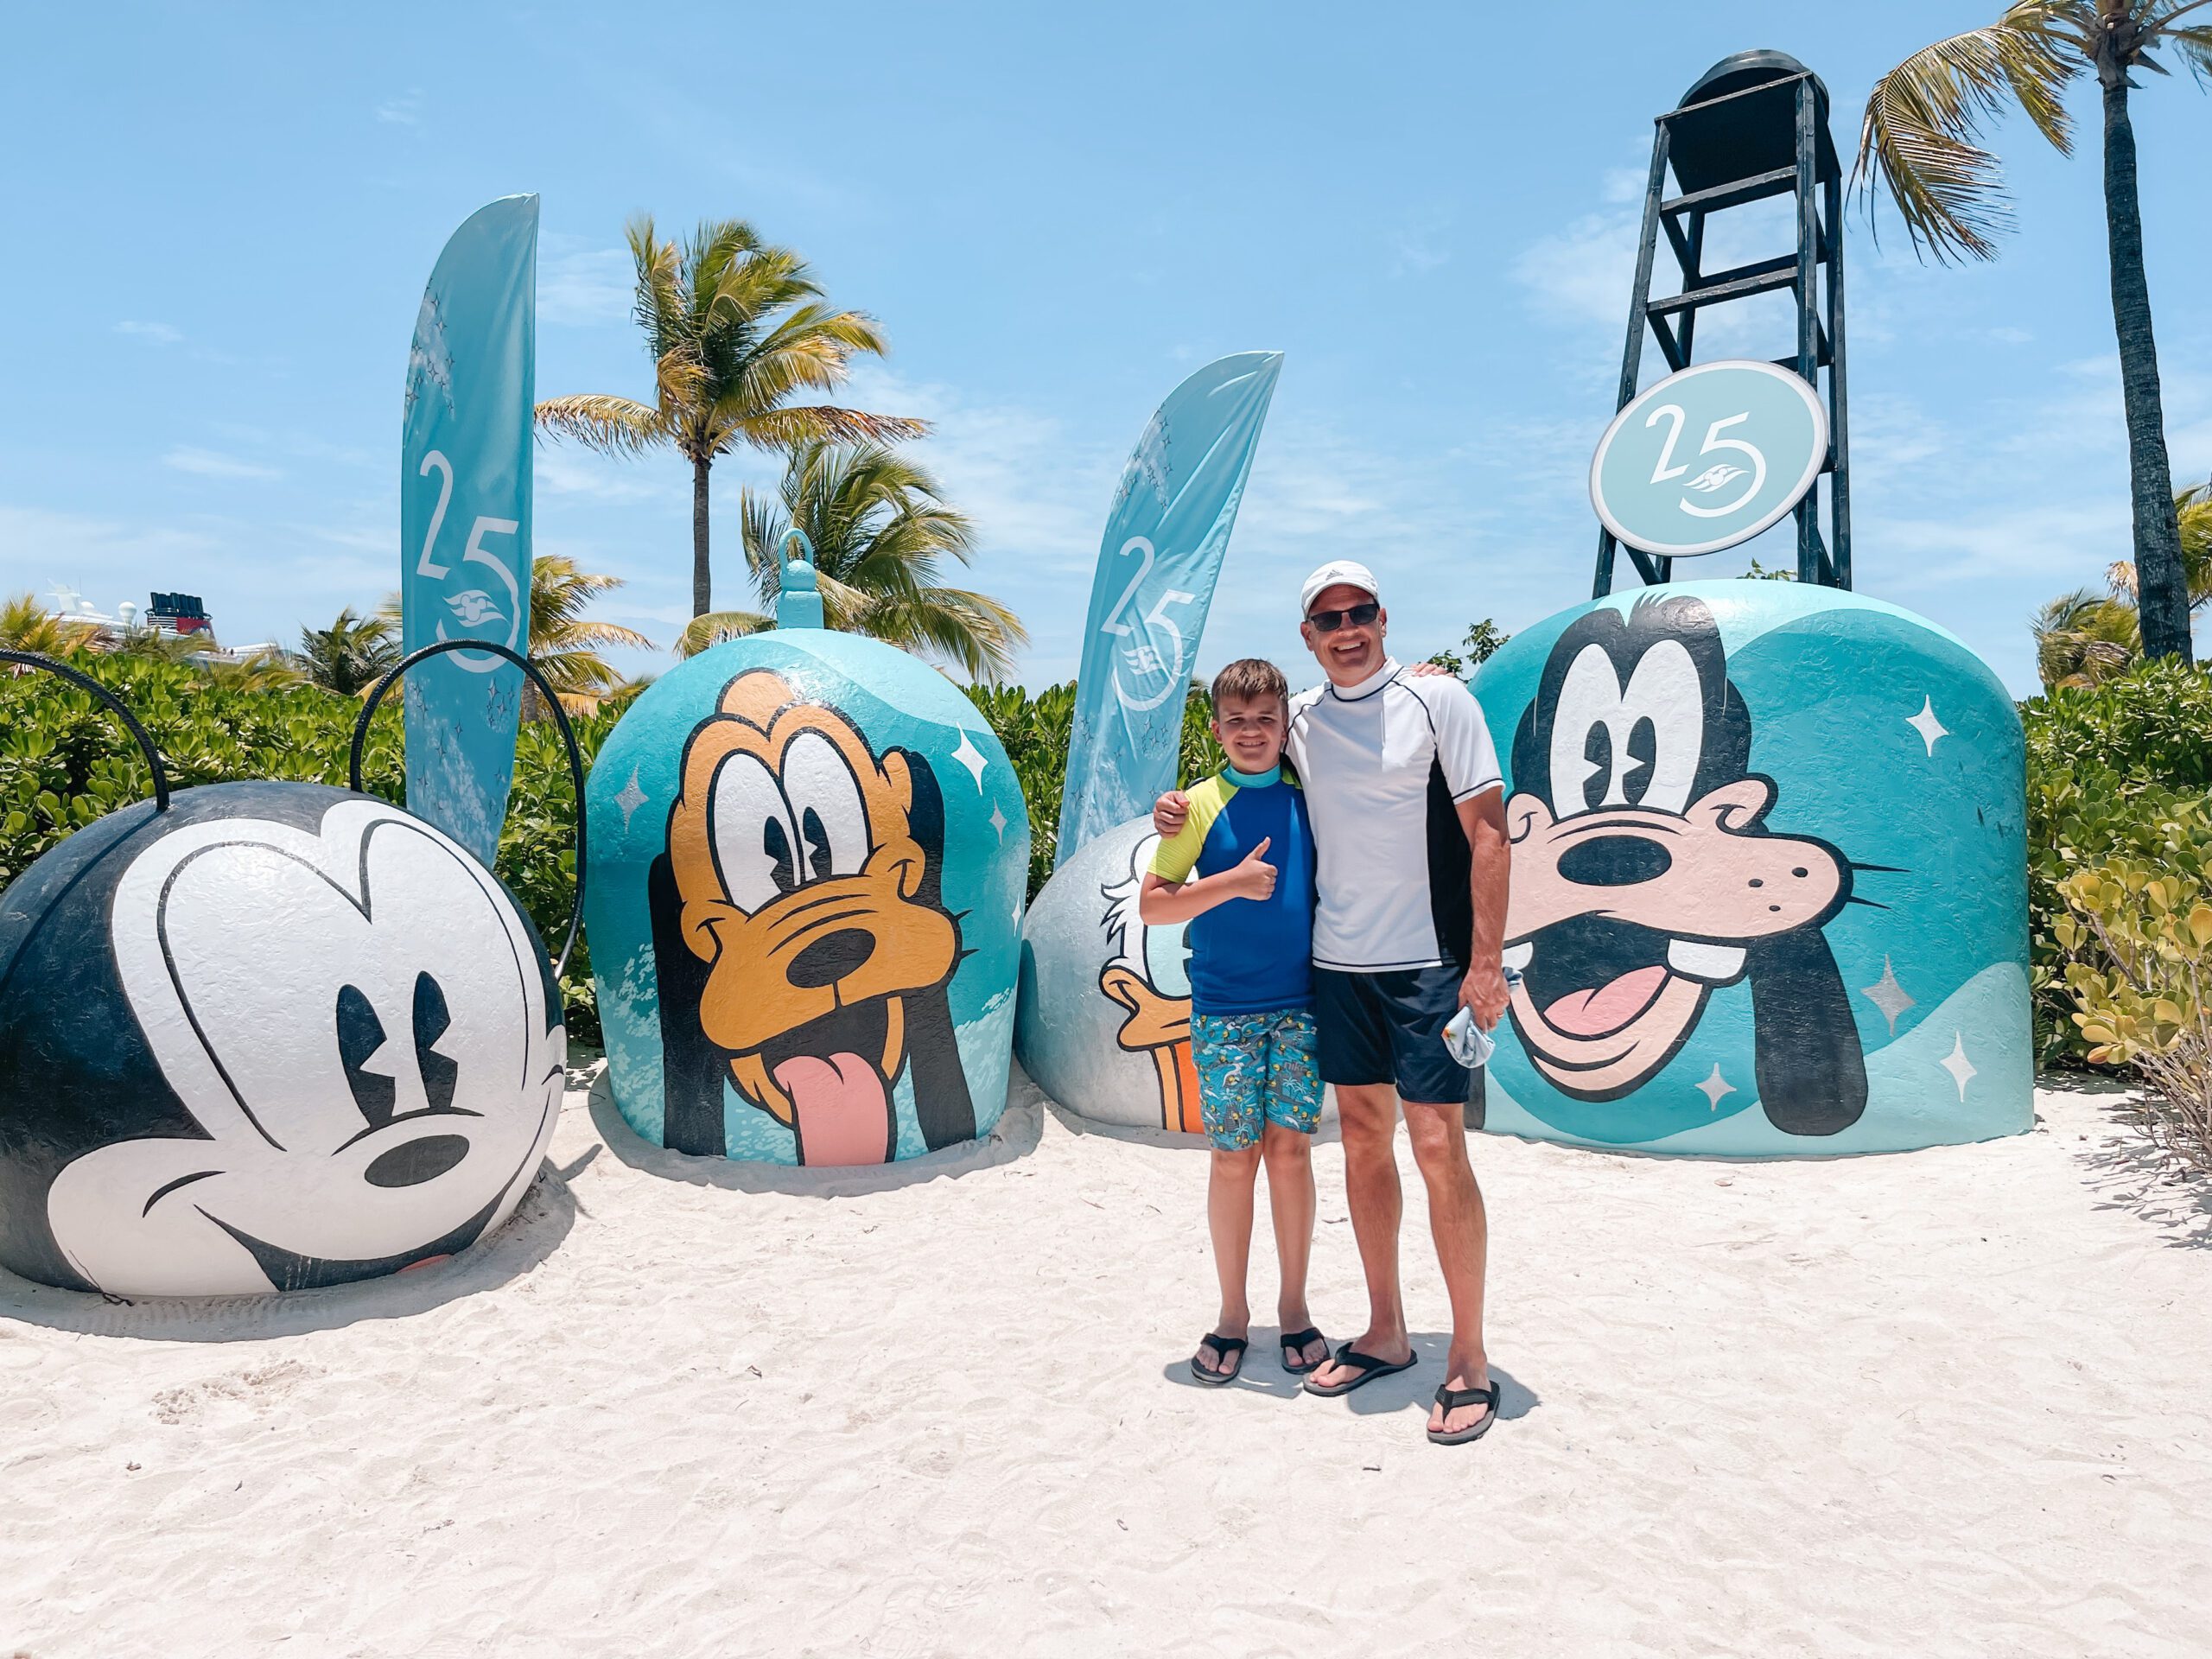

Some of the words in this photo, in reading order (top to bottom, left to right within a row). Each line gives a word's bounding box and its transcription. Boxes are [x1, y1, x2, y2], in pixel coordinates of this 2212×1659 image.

[1645, 404, 1767, 518] 25
[416, 449, 521, 673] 25
[1100, 536, 1196, 711] 25
